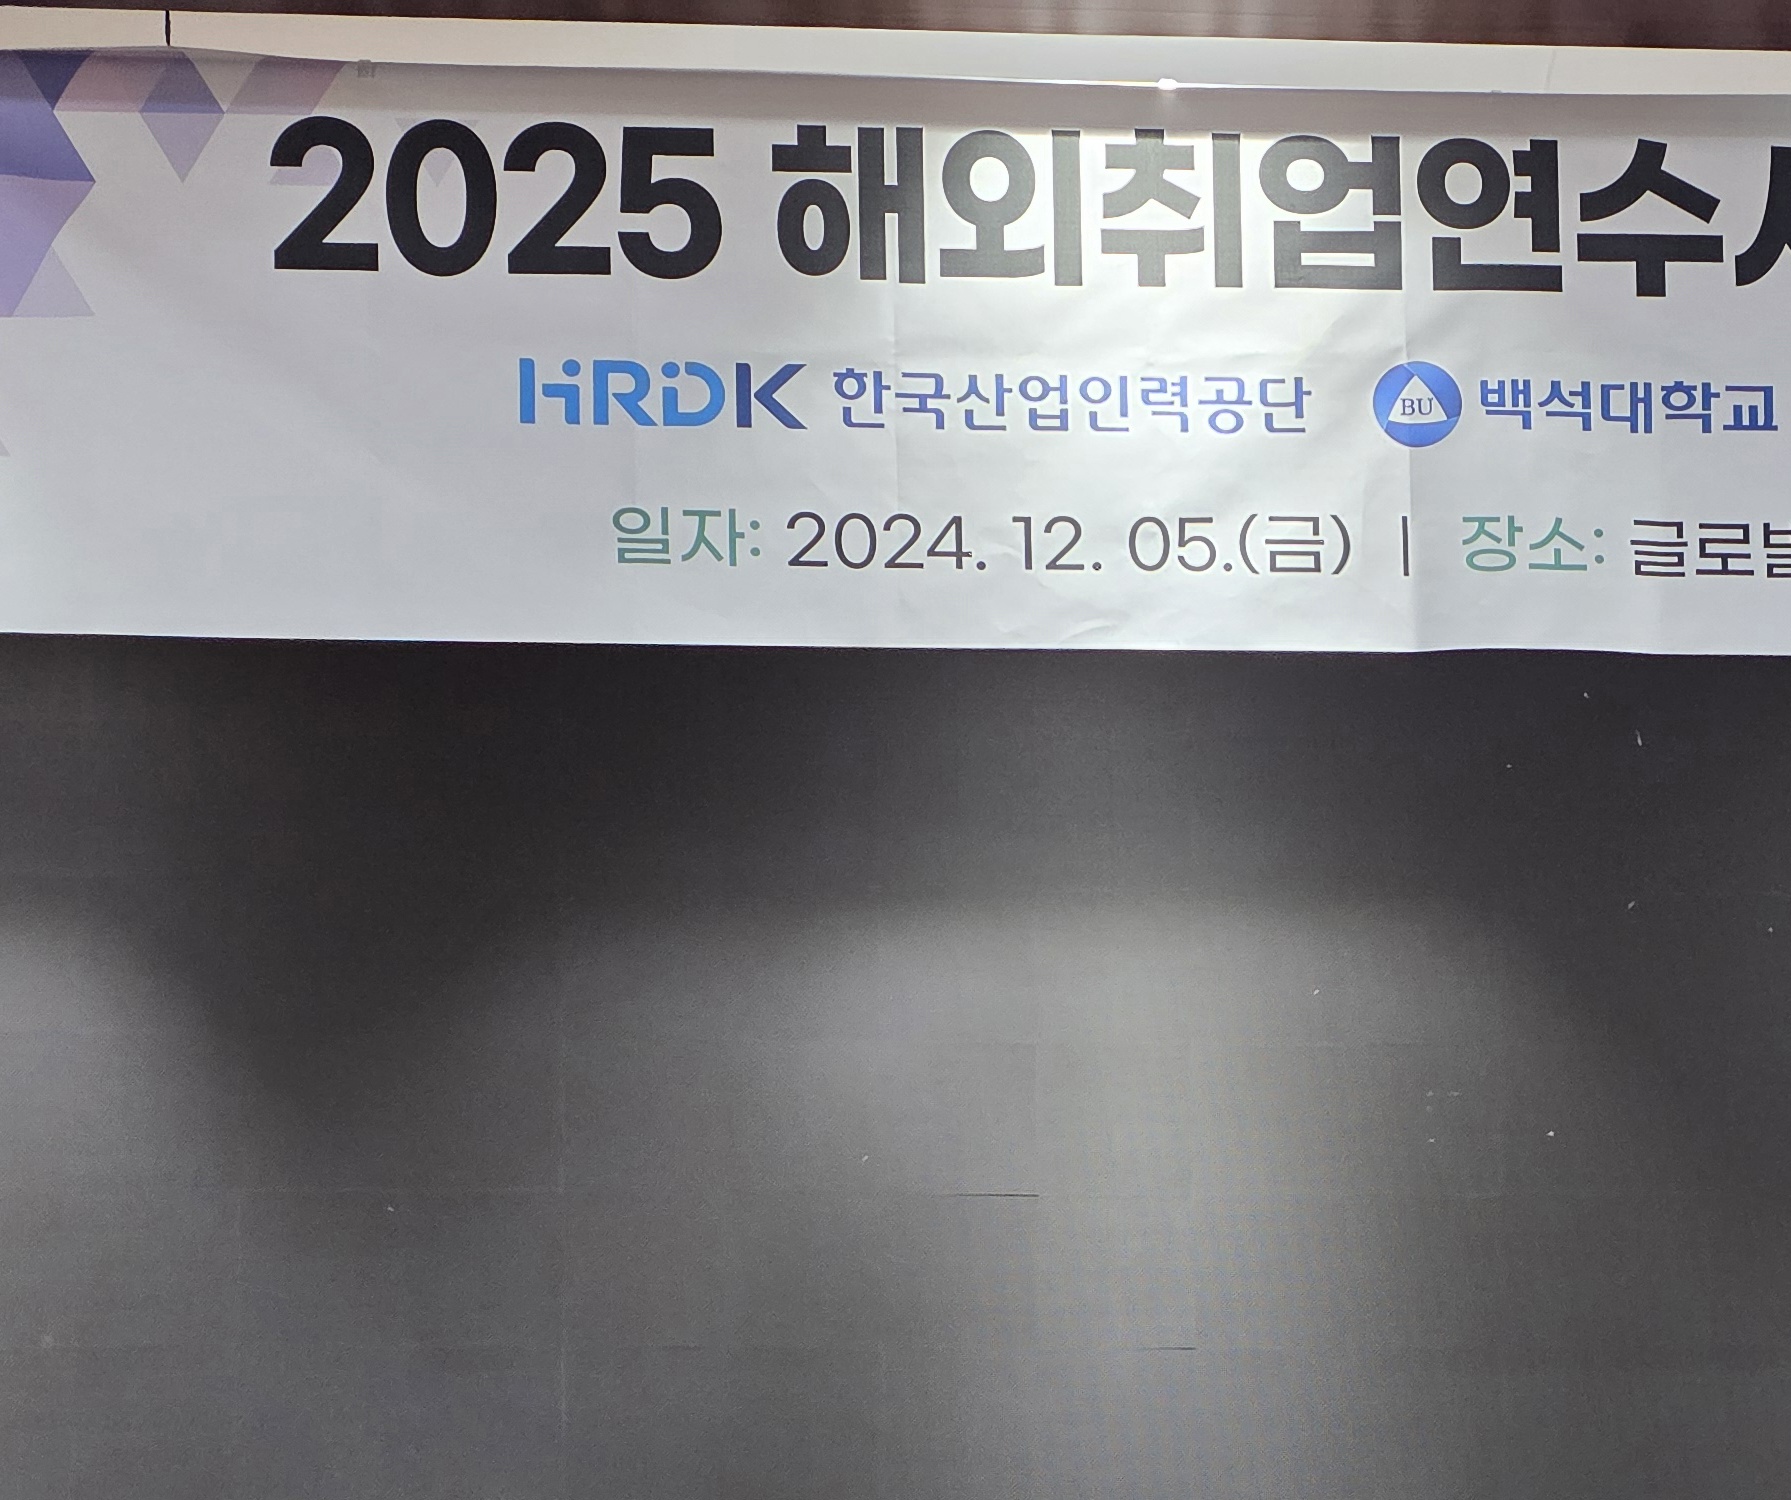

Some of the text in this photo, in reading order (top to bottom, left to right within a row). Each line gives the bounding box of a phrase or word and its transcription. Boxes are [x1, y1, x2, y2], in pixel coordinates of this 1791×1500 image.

[270, 115, 723, 280] 2025
[833, 368, 1312, 434] 한국산업인력공단
[1400, 397, 1434, 416] BU
[1480, 379, 1778, 434] 백석대학교
[613, 507, 760, 566] 일자:
[787, 512, 986, 570] 2024.
[1012, 516, 1101, 571] 12.
[1129, 514, 1350, 575] 05.(금)
[1462, 515, 1604, 572] 장소:
